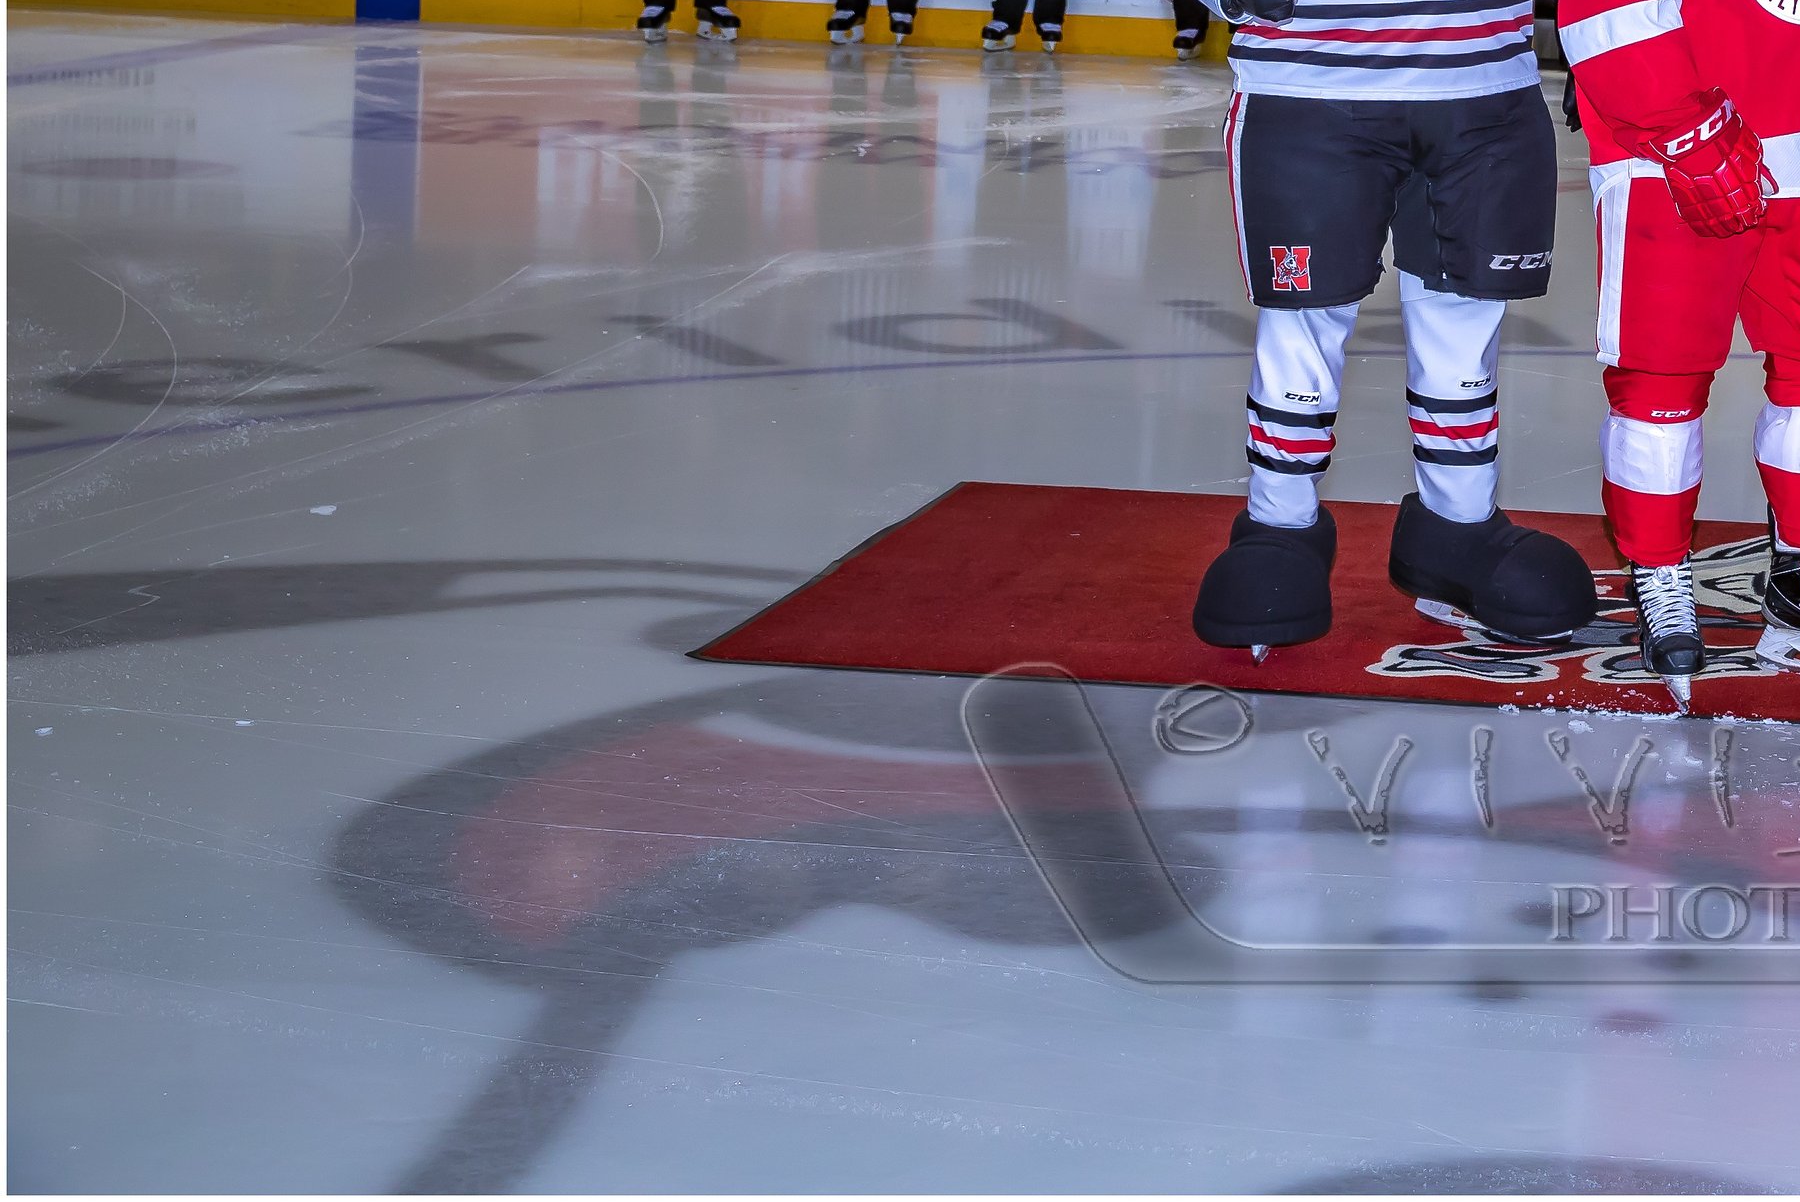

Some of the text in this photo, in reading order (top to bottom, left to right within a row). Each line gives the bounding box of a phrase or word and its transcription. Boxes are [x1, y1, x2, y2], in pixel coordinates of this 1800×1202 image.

[1459, 375, 1493, 390] CCM
[1284, 391, 1320, 404] CCM
[1650, 407, 1691, 419] CCM
